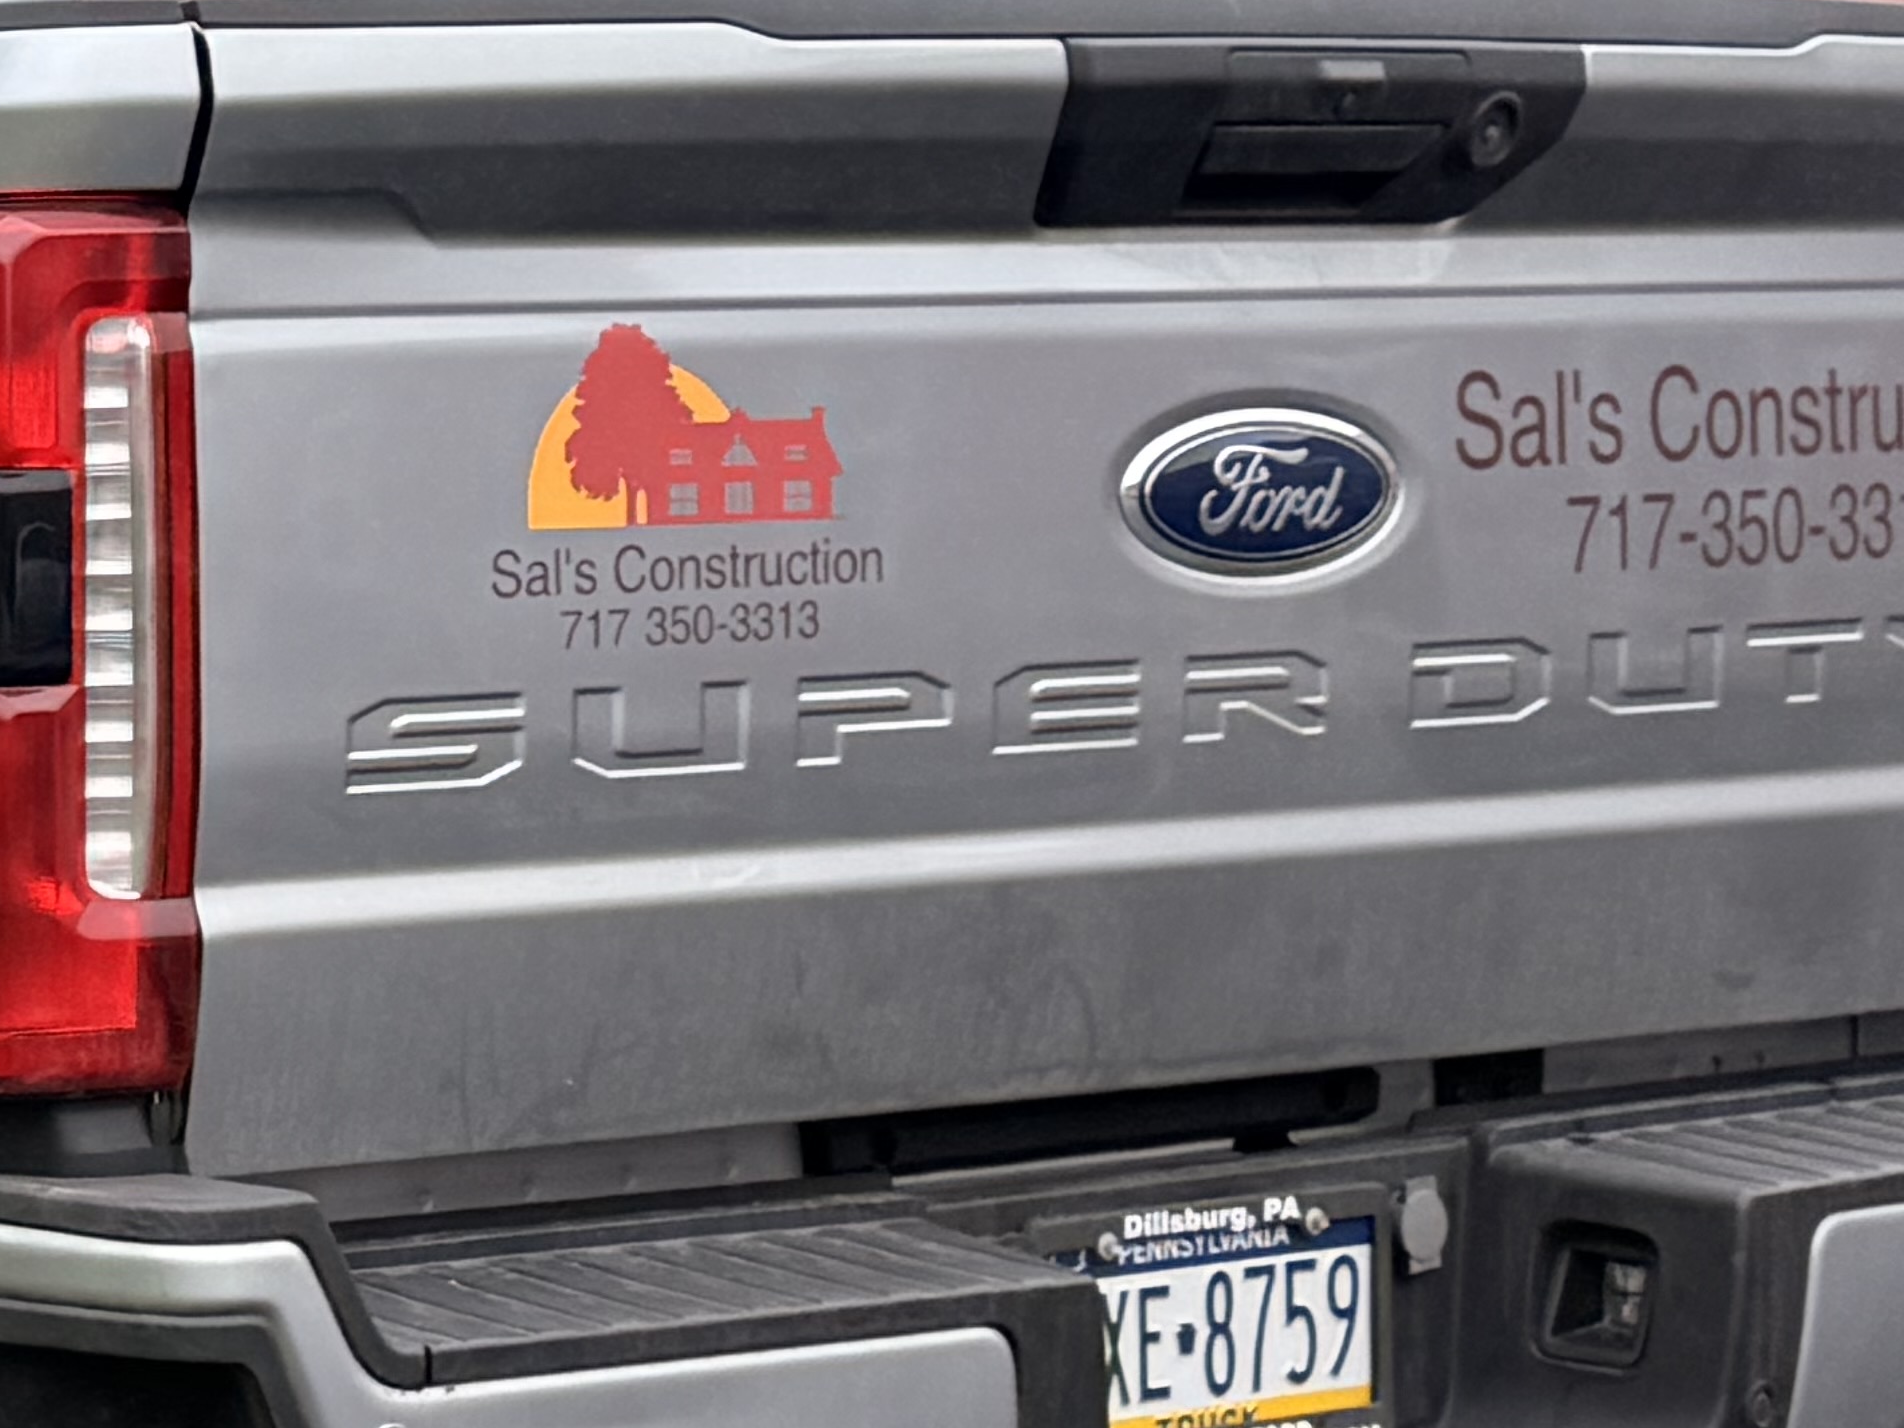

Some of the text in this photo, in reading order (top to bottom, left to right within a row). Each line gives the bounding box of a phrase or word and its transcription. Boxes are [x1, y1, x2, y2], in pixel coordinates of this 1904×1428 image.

[1455, 363, 1904, 470] Sal's Constru
[1198, 444, 1345, 537] Ford
[1566, 481, 1904, 573] 717-350-33
[492, 537, 884, 598] Sal's Construction
[559, 600, 820, 649] 717 350-3313
[346, 614, 1904, 795] SUPER DUT
[1124, 1196, 1301, 1240] Dillsburg, PA
